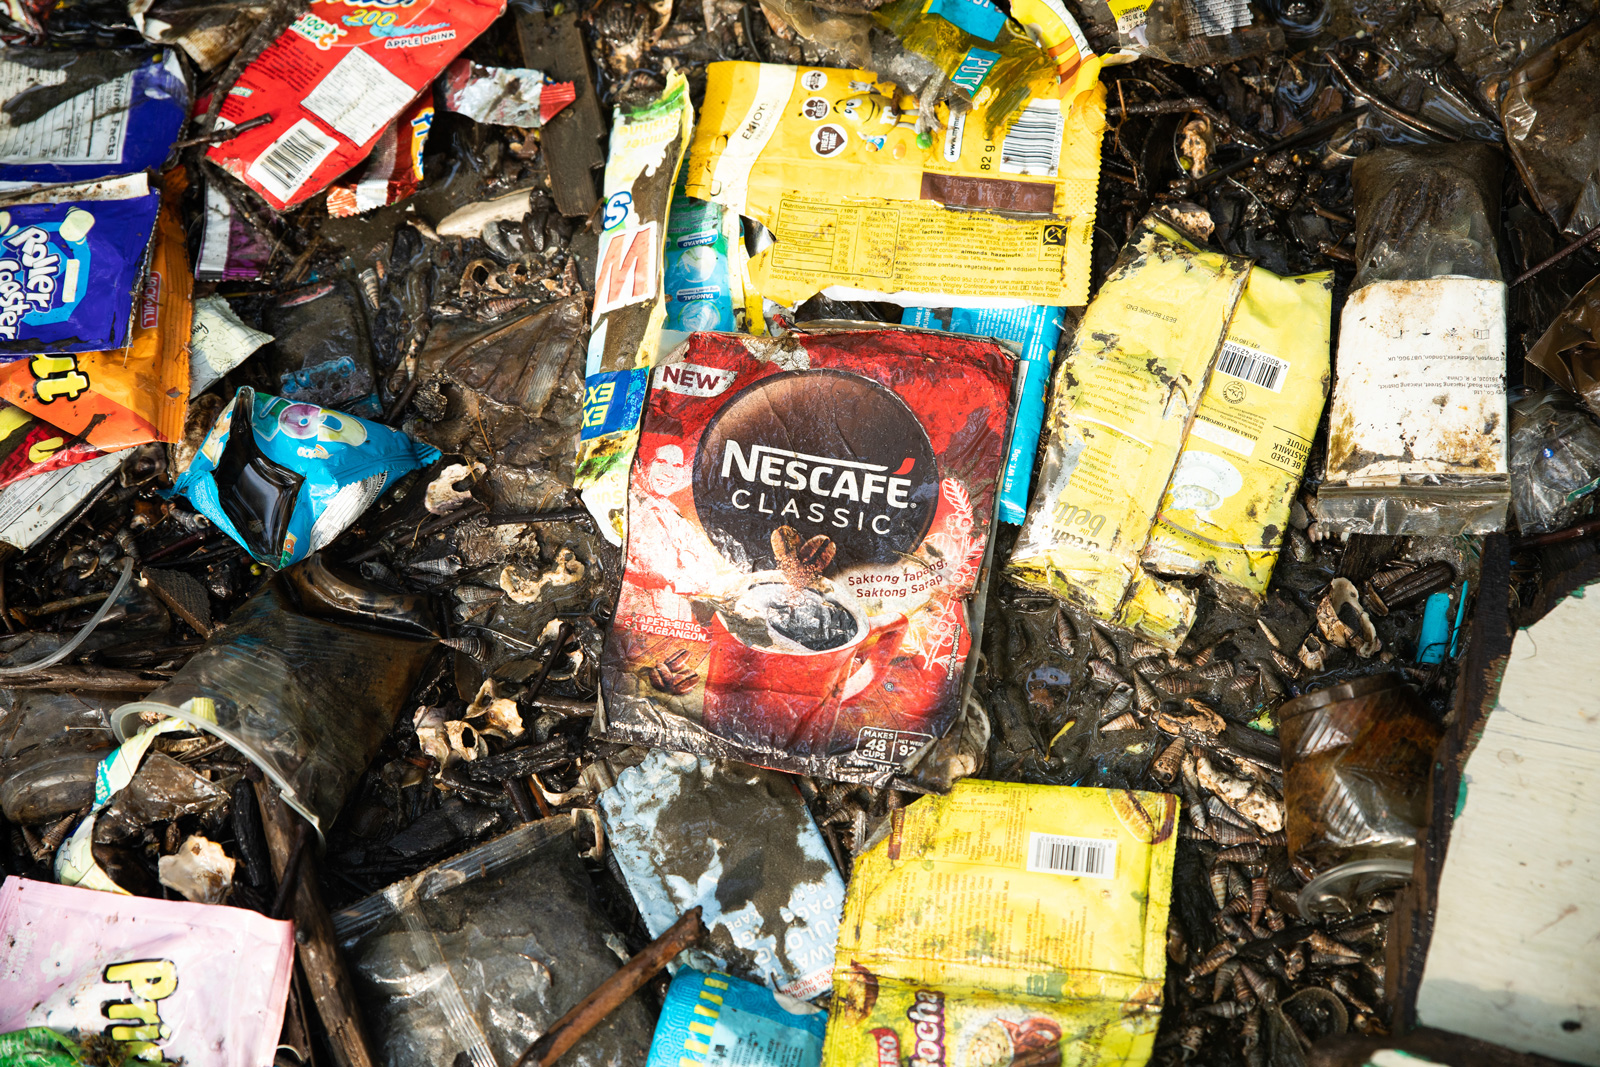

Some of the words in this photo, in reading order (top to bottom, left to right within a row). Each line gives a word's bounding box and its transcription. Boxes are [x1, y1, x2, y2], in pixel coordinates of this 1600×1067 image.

[345, 9, 397, 27] 200
[386, 37, 420, 48] APPLE
[423, 31, 455, 44] DRINK
[107, 119, 120, 156] Facts
[981, 156, 991, 170] 82
[783, 202, 806, 210] Nutrition
[5, 226, 60, 313] Roller
[1126, 303, 1138, 313] END
[1139, 307, 1162, 320] BEFORE
[1161, 313, 1178, 324] BEST
[1223, 342, 1250, 356] 425026
[1253, 353, 1280, 367] 800575
[661, 365, 721, 391] NEW
[1011, 448, 1022, 462] 30g
[1271, 452, 1289, 465] USED
[1273, 442, 1306, 461] EASTMILK
[1007, 462, 1017, 477] WT.
[1292, 459, 1301, 470] BE
[1003, 478, 1012, 493] NET
[732, 489, 892, 535] CLASSIC
[848, 574, 900, 586] Saktong
[903, 559, 948, 583] Tapang,
[856, 587, 907, 598] Saktong
[911, 574, 943, 594] Sarap
[624, 620, 641, 631] SA
[641, 623, 707, 641] PAGBANGON
[863, 730, 895, 740] MAKES
[865, 739, 887, 752] 48
[862, 750, 886, 760] CUPS
[907, 989, 947, 1067] ocha
